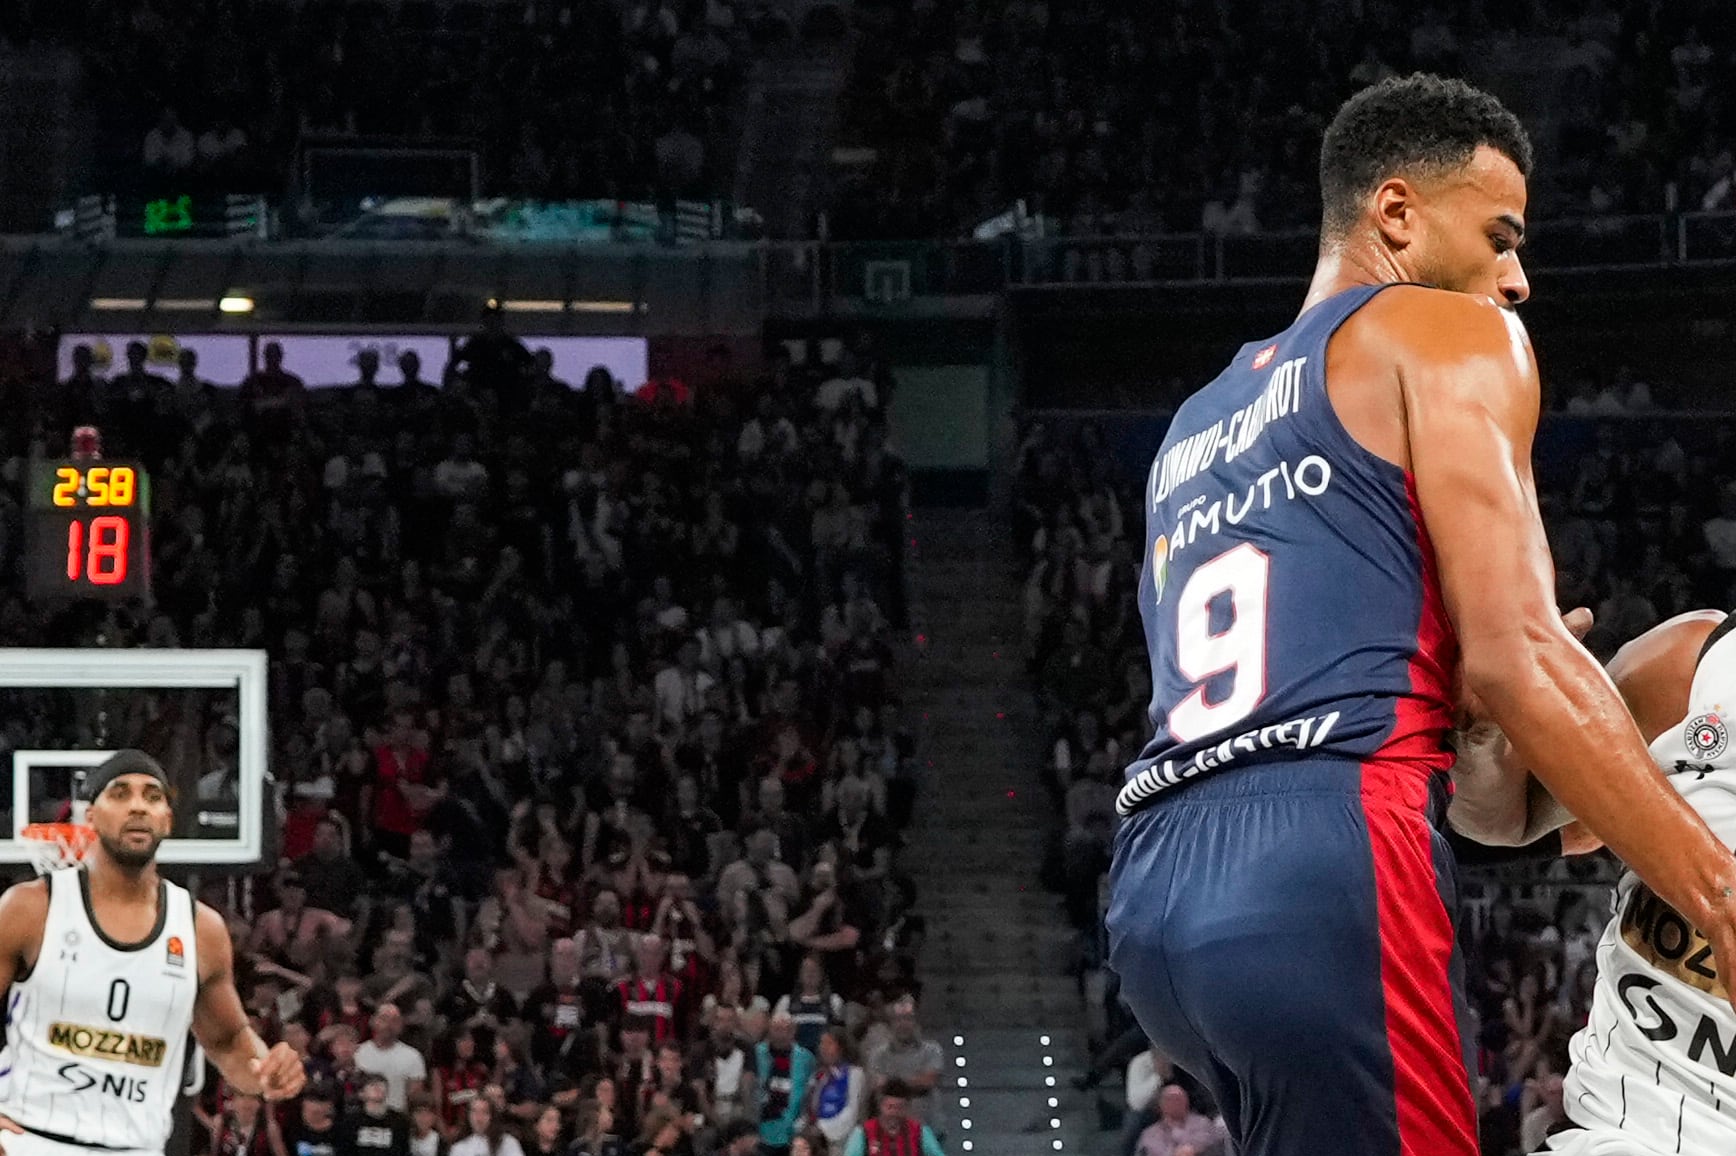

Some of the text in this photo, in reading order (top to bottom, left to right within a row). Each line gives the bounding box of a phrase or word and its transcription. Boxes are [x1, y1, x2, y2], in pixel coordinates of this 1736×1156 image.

[53, 466, 135, 507] 2:58
[1169, 455, 1331, 561] AMUTIO
[67, 515, 130, 585] 18
[1168, 541, 1269, 744] 9
[107, 978, 130, 1022] 0
[50, 1023, 167, 1065] MOZZART
[102, 1073, 148, 1103] NIS
